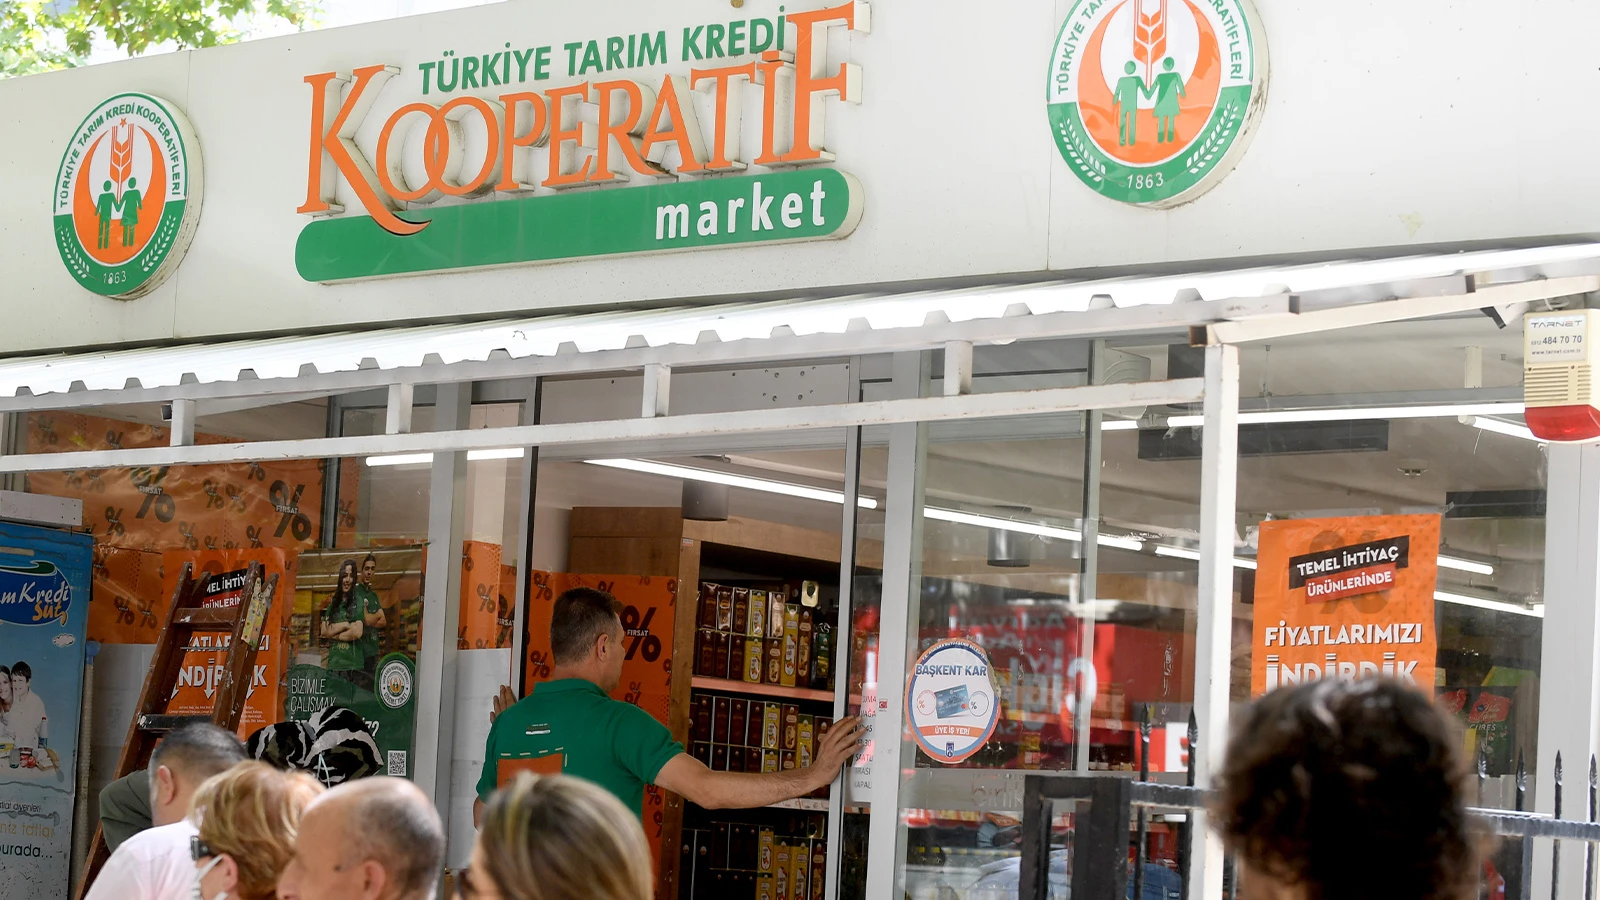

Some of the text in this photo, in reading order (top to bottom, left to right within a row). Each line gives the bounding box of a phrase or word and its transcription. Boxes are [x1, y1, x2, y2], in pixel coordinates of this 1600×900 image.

[419, 5, 786, 96] TÜRKİYE TARIM KREDİ
[1056, 21, 1086, 95] TÜRKİYE
[296, 1, 855, 236] KOOPERATİF
[60, 148, 80, 208] TÜRKİYE
[77, 115, 105, 147] TARIM
[105, 102, 135, 121] KREDİ
[1126, 172, 1164, 189] 1863
[656, 179, 826, 241] market
[103, 270, 127, 285] 1863
[1531, 320, 1583, 328] TARNET
[1542, 336, 1557, 345] 484
[1559, 335, 1570, 344] 70
[1572, 335, 1582, 343] 70
[138, 486, 163, 496] FIRSAT
[275, 505, 299, 515] FIRSAT
[1297, 545, 1399, 577] TEMEL İHTİYAÇ
[18, 580, 70, 604] Kredi
[1307, 571, 1393, 597] ÜRÜNLERİNDE
[32, 600, 68, 626] Süt
[627, 629, 649, 637] FIRSAT
[1264, 620, 1423, 647] FİYATLARIMIZI
[915, 665, 963, 678] BAŞKENT
[291, 676, 327, 695] BİZİMLE
[934, 725, 970, 735] ÜYE İŞ YERİ
[0, 843, 53, 858] urada...
